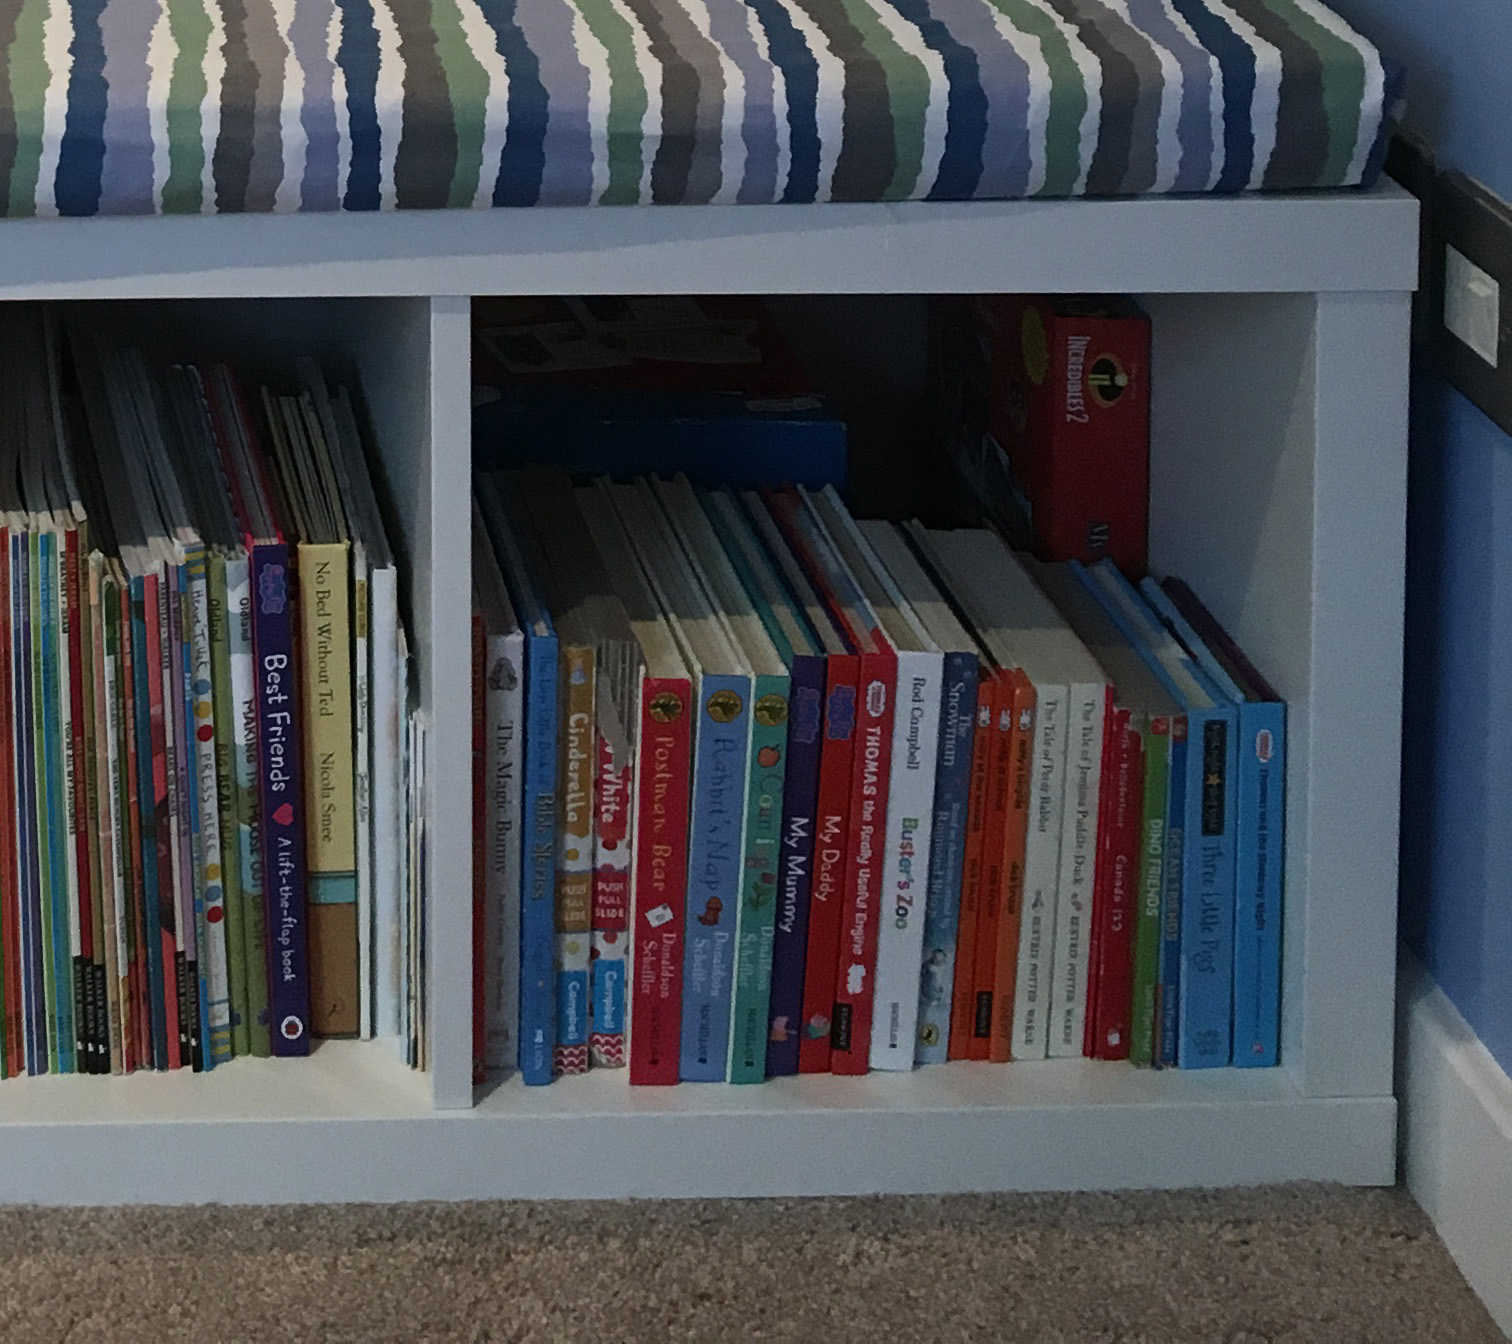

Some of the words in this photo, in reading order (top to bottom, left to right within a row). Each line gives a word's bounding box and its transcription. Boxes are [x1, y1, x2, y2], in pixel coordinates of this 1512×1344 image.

[1067, 335, 1091, 412] INCREDIBLES
[1066, 413, 1089, 423] 2
[316, 561, 331, 585] No
[210, 598, 222, 642] Oldland
[316, 589, 332, 617] Bed
[318, 622, 333, 684] Without
[264, 653, 289, 704] Best
[911, 677, 927, 703] Rod
[319, 689, 334, 717] Ted
[943, 682, 965, 766] Snowman
[1045, 700, 1058, 721] The
[1083, 700, 1095, 721] The
[497, 721, 514, 755] The
[907, 707, 925, 770] Campbell
[958, 715, 971, 737] The
[1043, 725, 1056, 746] Tale
[269, 711, 291, 792] Friends
[566, 712, 589, 822] Cinderella
[863, 726, 880, 795] THOMAS
[1042, 749, 1055, 763] of
[1081, 749, 1093, 762] of
[201, 753, 213, 803] PRESS
[217, 774, 231, 812] BEAR
[320, 752, 336, 799] Nicola
[493, 761, 514, 813] Magic
[654, 736, 675, 832] Postman
[1078, 764, 1092, 806] Jemima
[204, 812, 216, 851] HERE
[321, 803, 336, 842] Smee
[819, 816, 842, 843] My
[862, 800, 874, 821] the
[1075, 810, 1088, 849] Puddle
[278, 837, 292, 848] A
[491, 820, 513, 874] Bunny
[784, 816, 809, 848] My
[856, 825, 873, 865] Really
[1149, 818, 1163, 854] DINO
[652, 844, 672, 891] Bear
[898, 817, 920, 890] Buster's
[1072, 855, 1086, 885] Duck
[778, 855, 807, 933] Mummy
[815, 849, 840, 901] Daddy
[855, 869, 871, 908] Useful
[1113, 854, 1127, 902] Canada
[1146, 859, 1162, 917] FRIENDS
[278, 851, 297, 945] lift-the-flap
[895, 894, 914, 930] Zoo
[850, 913, 867, 955] Engine
[1069, 916, 1080, 959] BEATRIX
[282, 949, 297, 982] book
[641, 939, 658, 995] Scheffler
[659, 933, 677, 998] Donaldson
[1066, 963, 1077, 1002] POTTER
[567, 981, 580, 1040] Campbell
[603, 971, 617, 1028] Campbell
